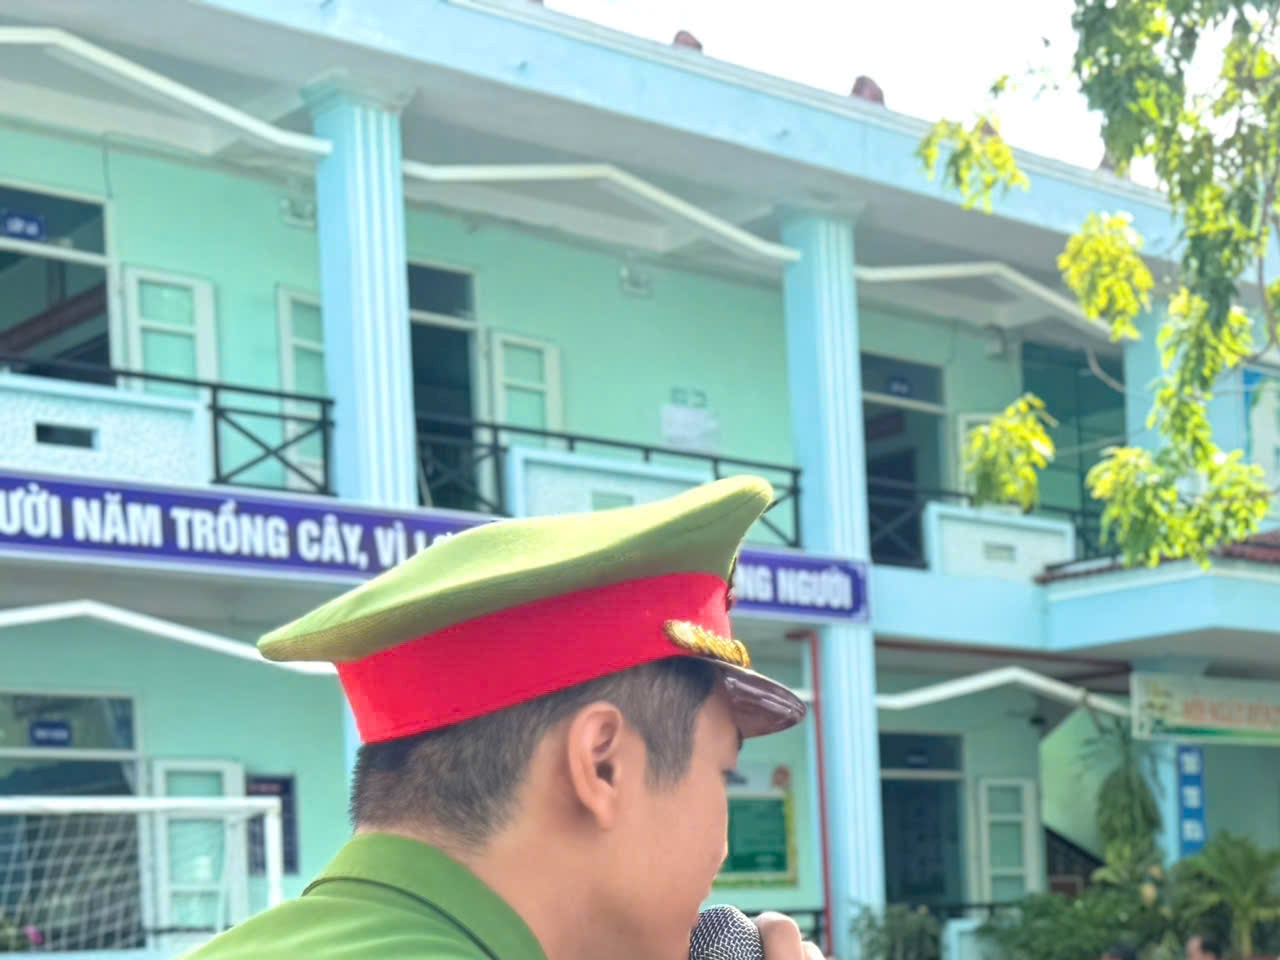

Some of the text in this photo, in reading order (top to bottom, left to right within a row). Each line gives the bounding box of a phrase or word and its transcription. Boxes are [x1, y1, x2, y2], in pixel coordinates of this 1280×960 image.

[0, 482, 63, 539] ƯỜI
[71, 491, 164, 548] NĂM
[296, 512, 369, 569] CÂY,
